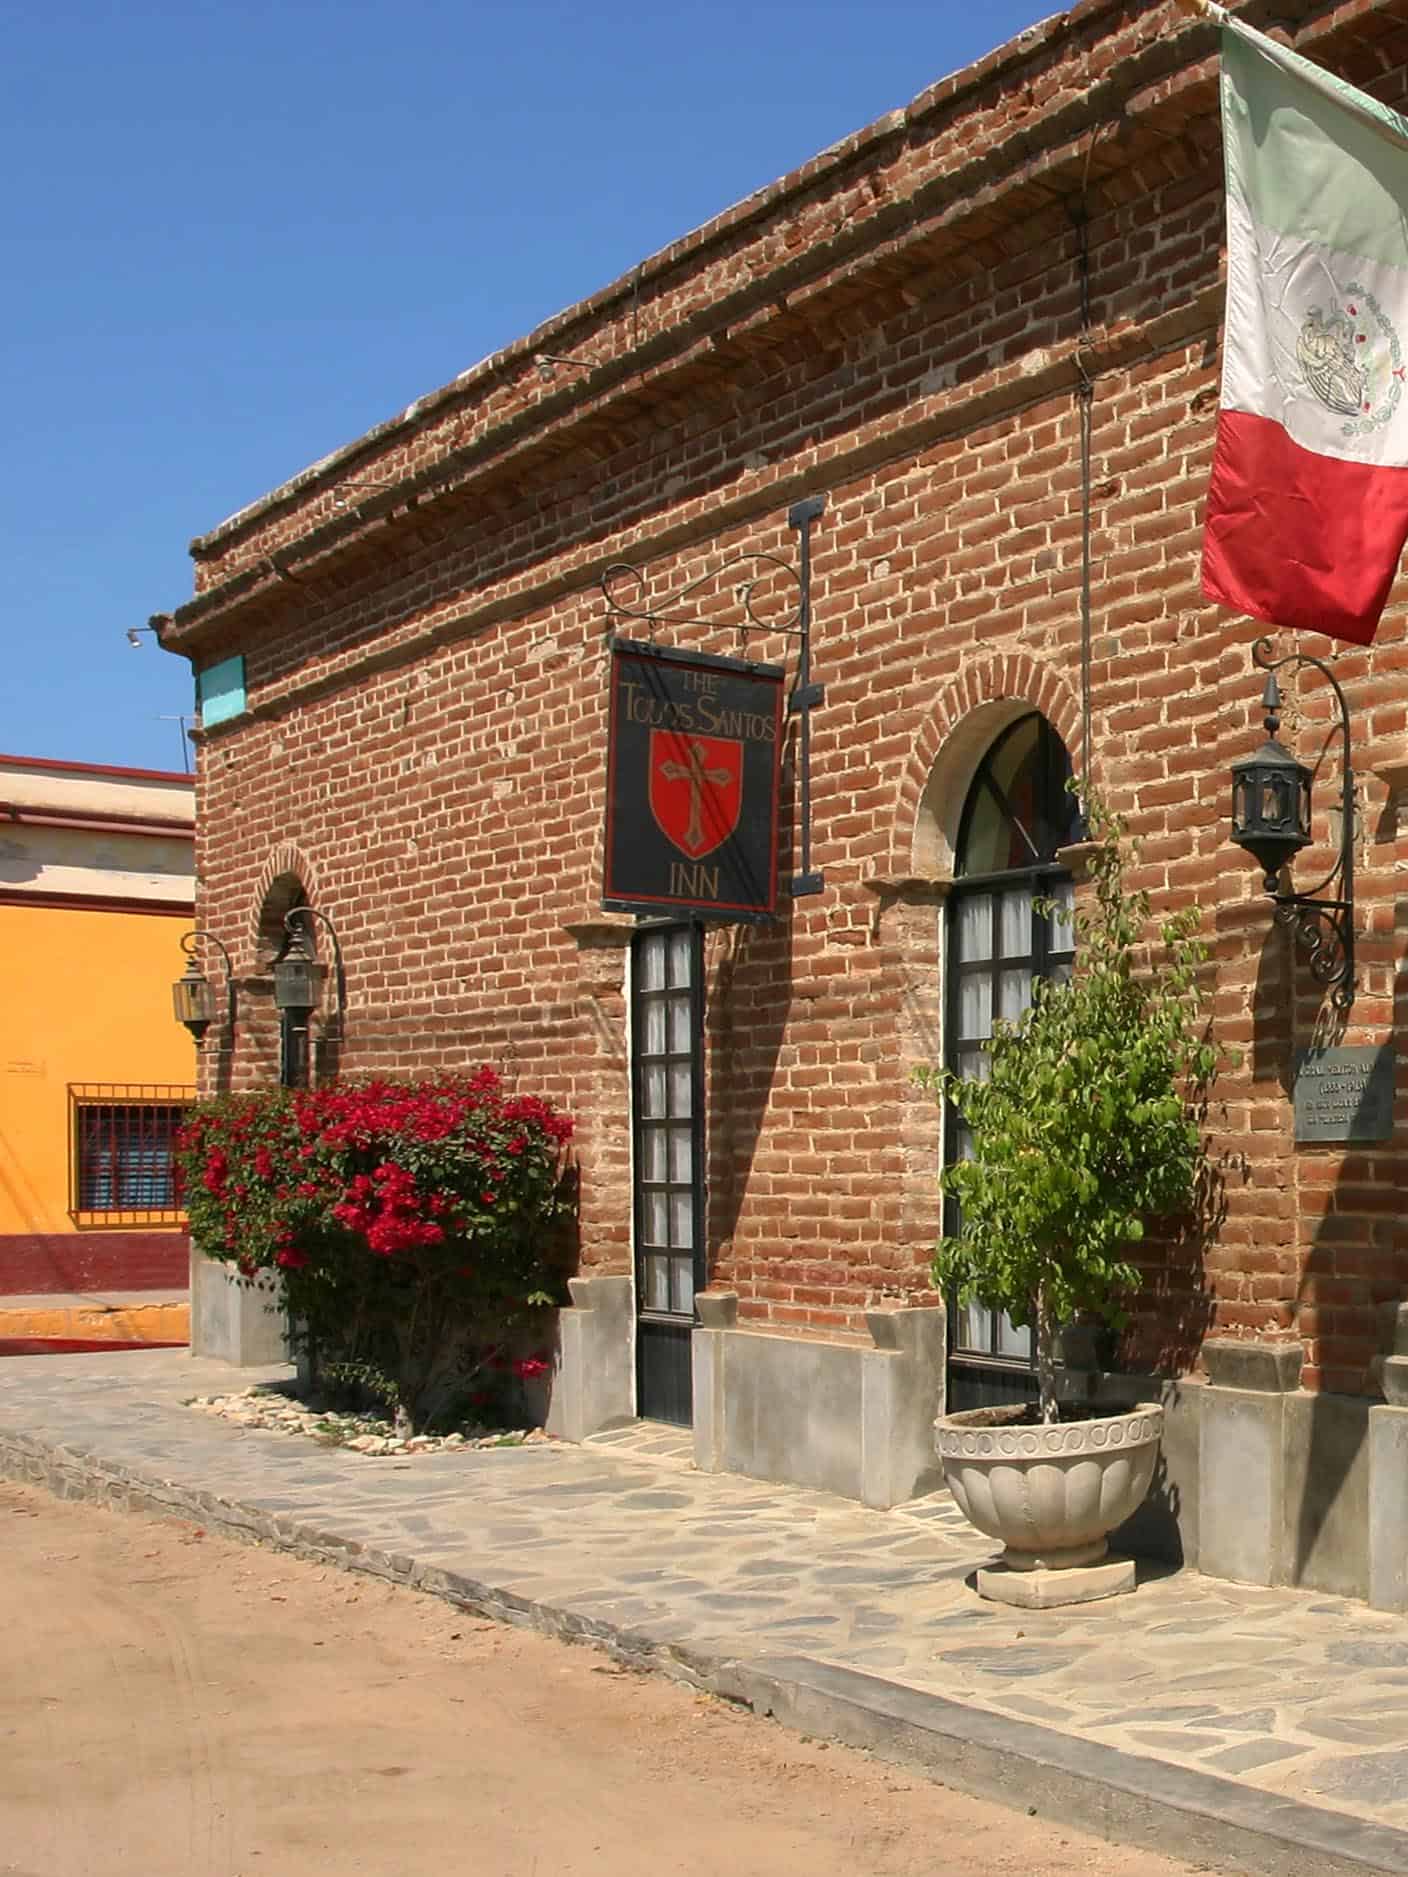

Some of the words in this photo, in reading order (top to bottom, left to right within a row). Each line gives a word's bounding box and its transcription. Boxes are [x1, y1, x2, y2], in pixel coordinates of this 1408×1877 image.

[682, 671, 720, 695] THE
[697, 694, 777, 742] SANTOS
[669, 862, 719, 899] INN
